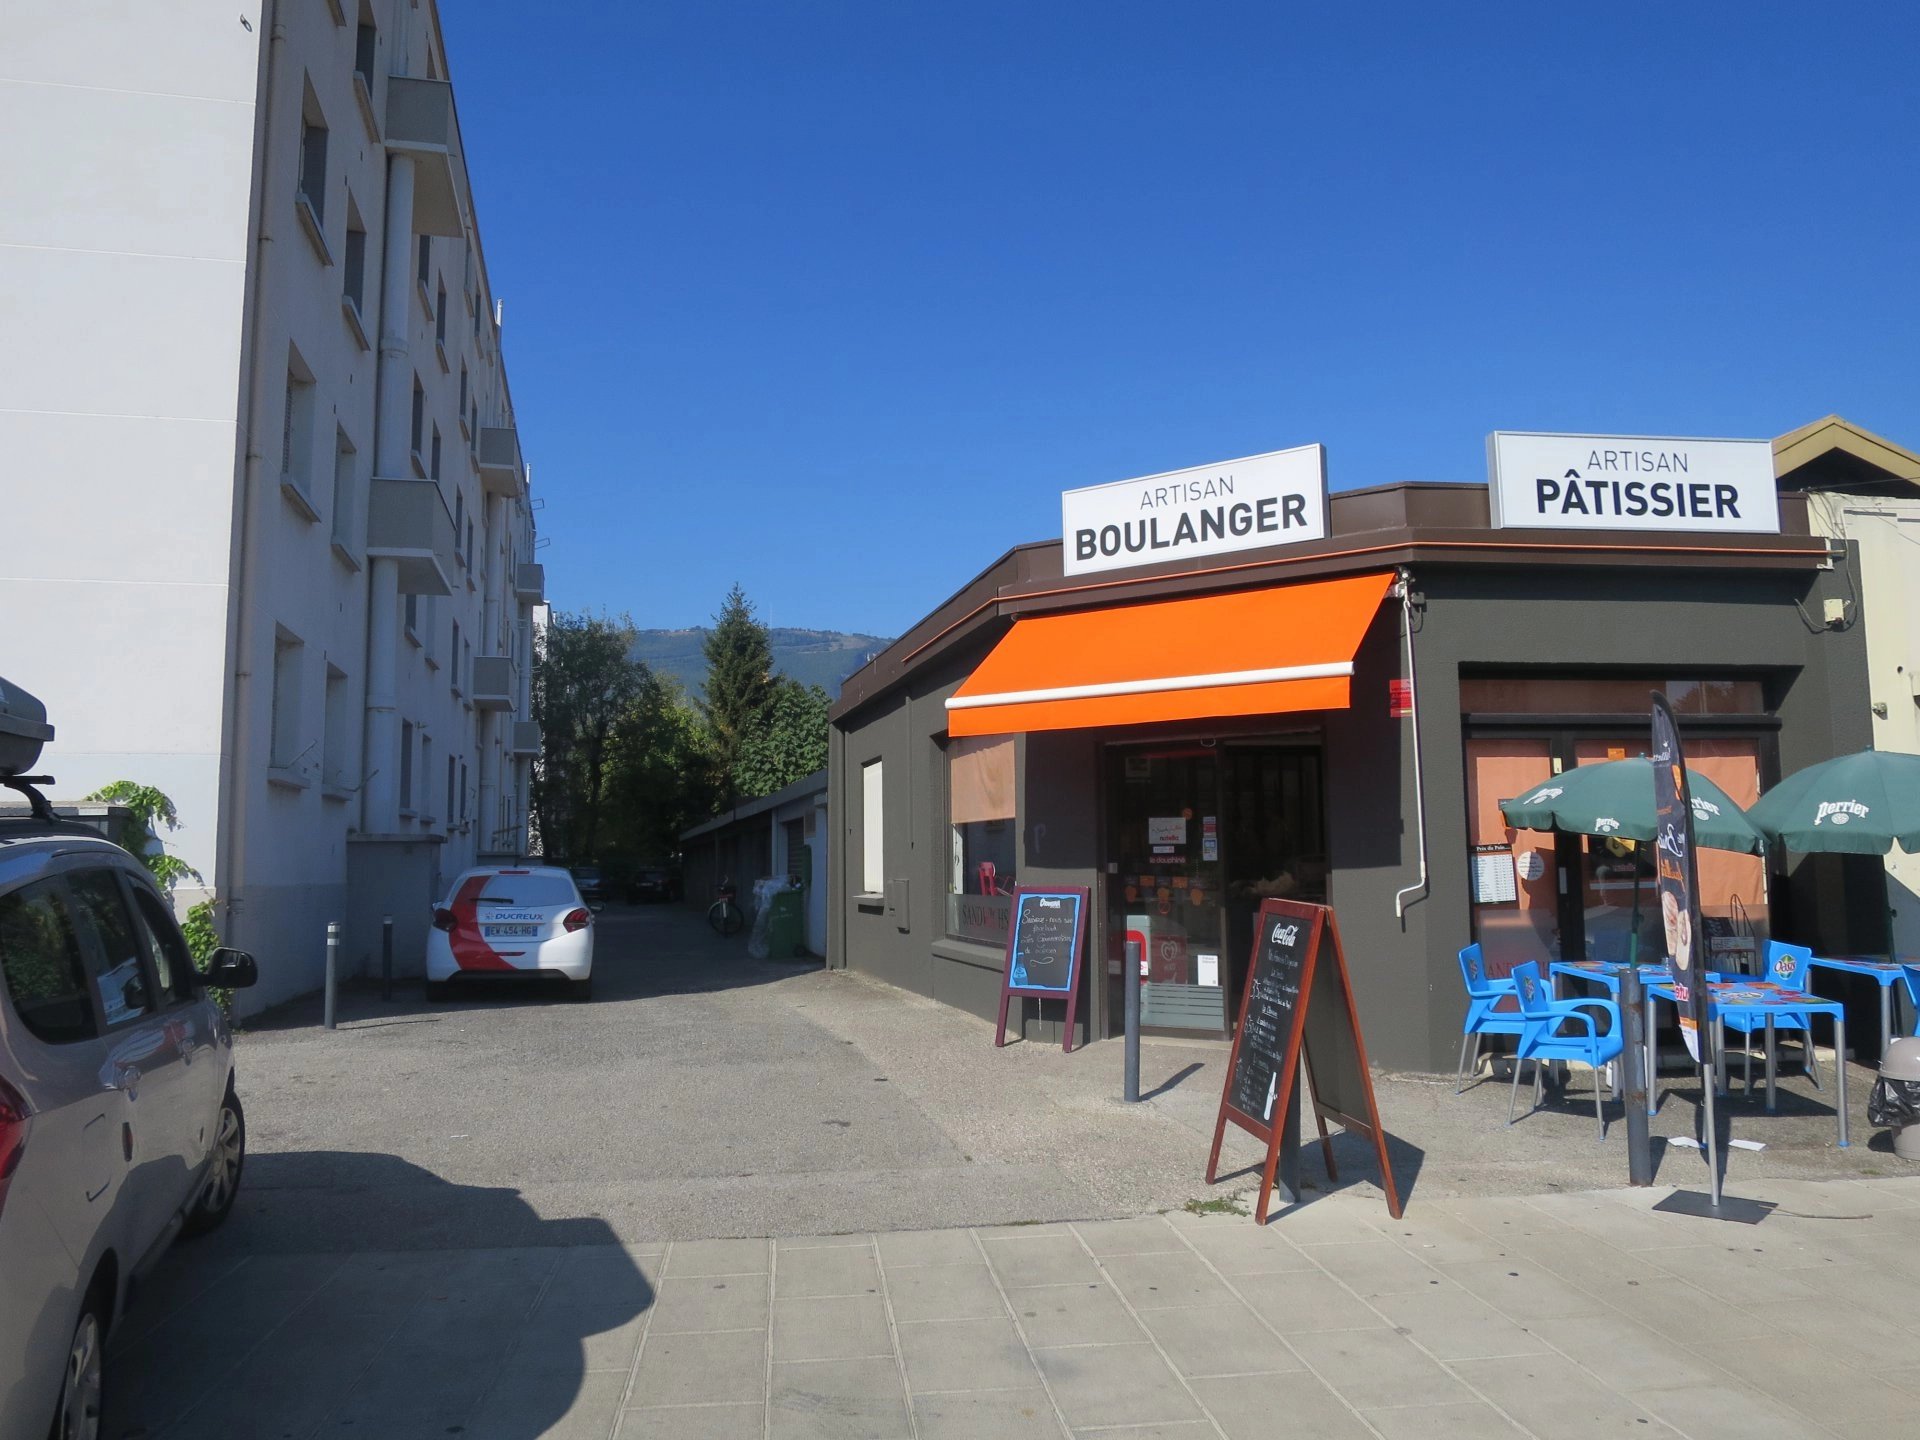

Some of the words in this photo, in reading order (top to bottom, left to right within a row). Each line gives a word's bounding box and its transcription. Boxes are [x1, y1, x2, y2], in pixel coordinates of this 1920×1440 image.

[1587, 450, 1688, 473] ARTISAN
[1140, 475, 1234, 510] ARTISAN
[1536, 469, 1741, 518] PÂTISSIER
[1076, 493, 1307, 560] BOULANGER
